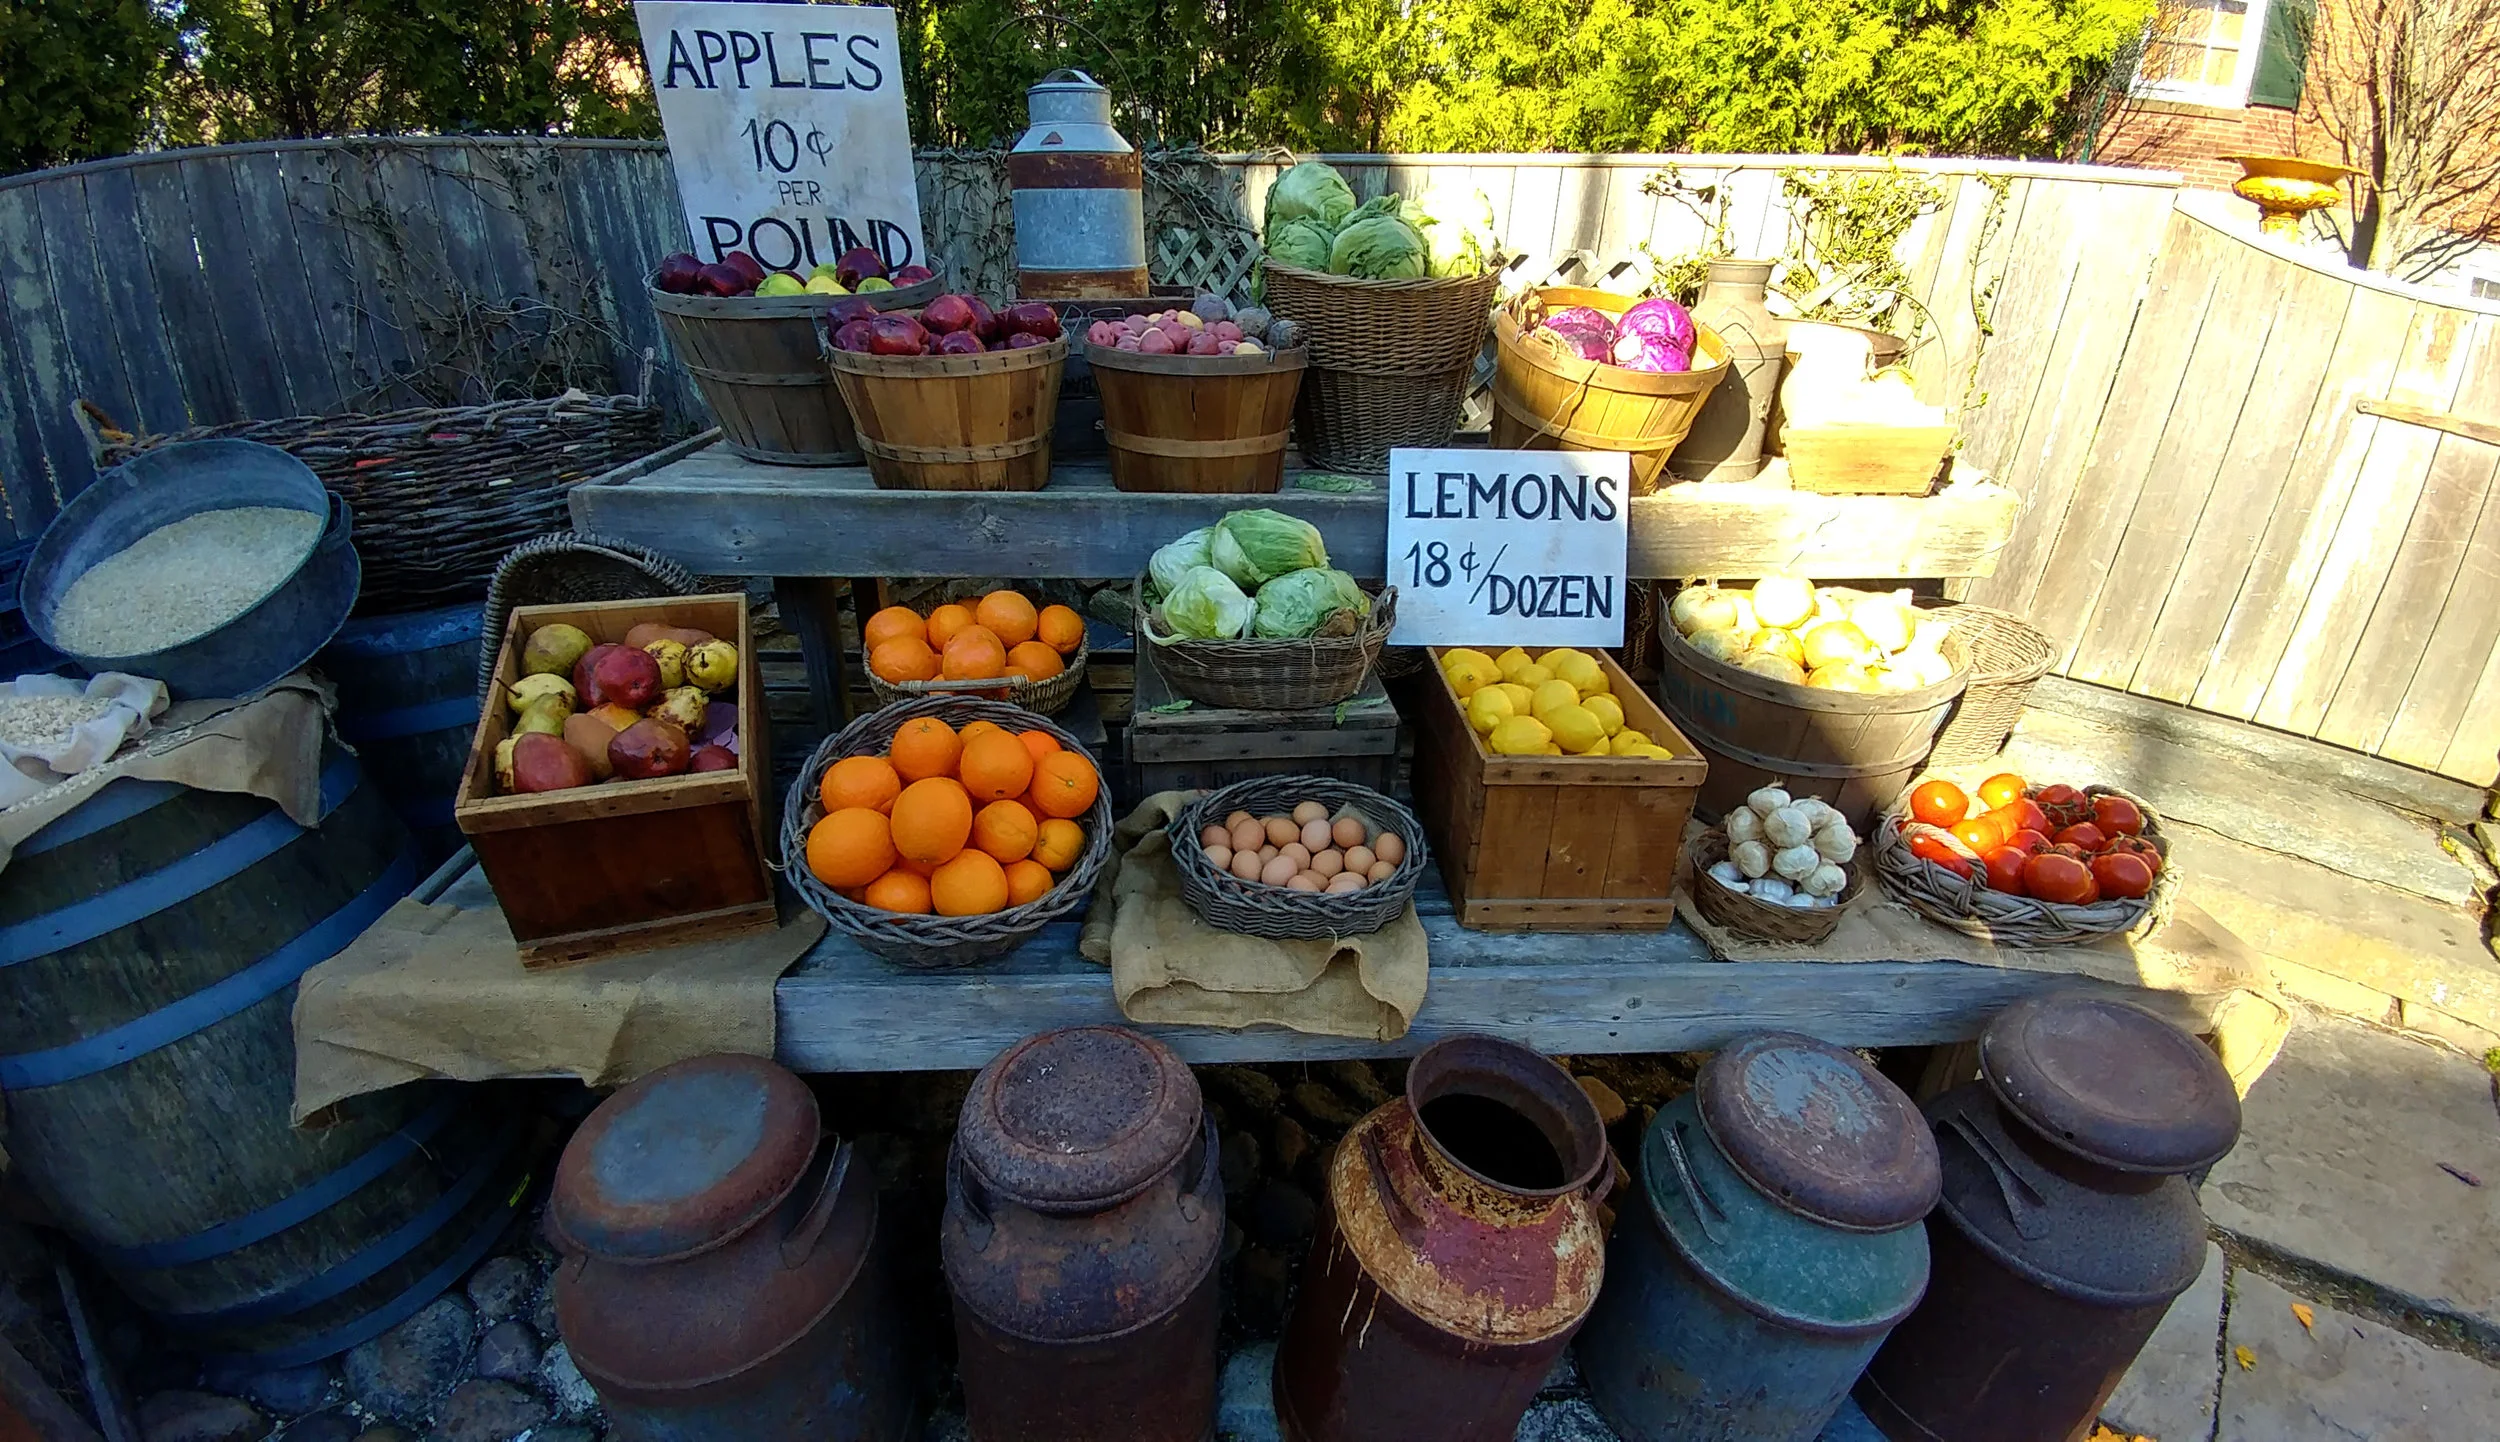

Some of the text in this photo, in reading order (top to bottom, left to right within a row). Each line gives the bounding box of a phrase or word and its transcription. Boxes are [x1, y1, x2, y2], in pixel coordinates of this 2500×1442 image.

[663, 29, 883, 91] APPLES
[777, 180, 822, 206] PER
[700, 216, 913, 273] POUND
[1405, 472, 1618, 521] LEMONS
